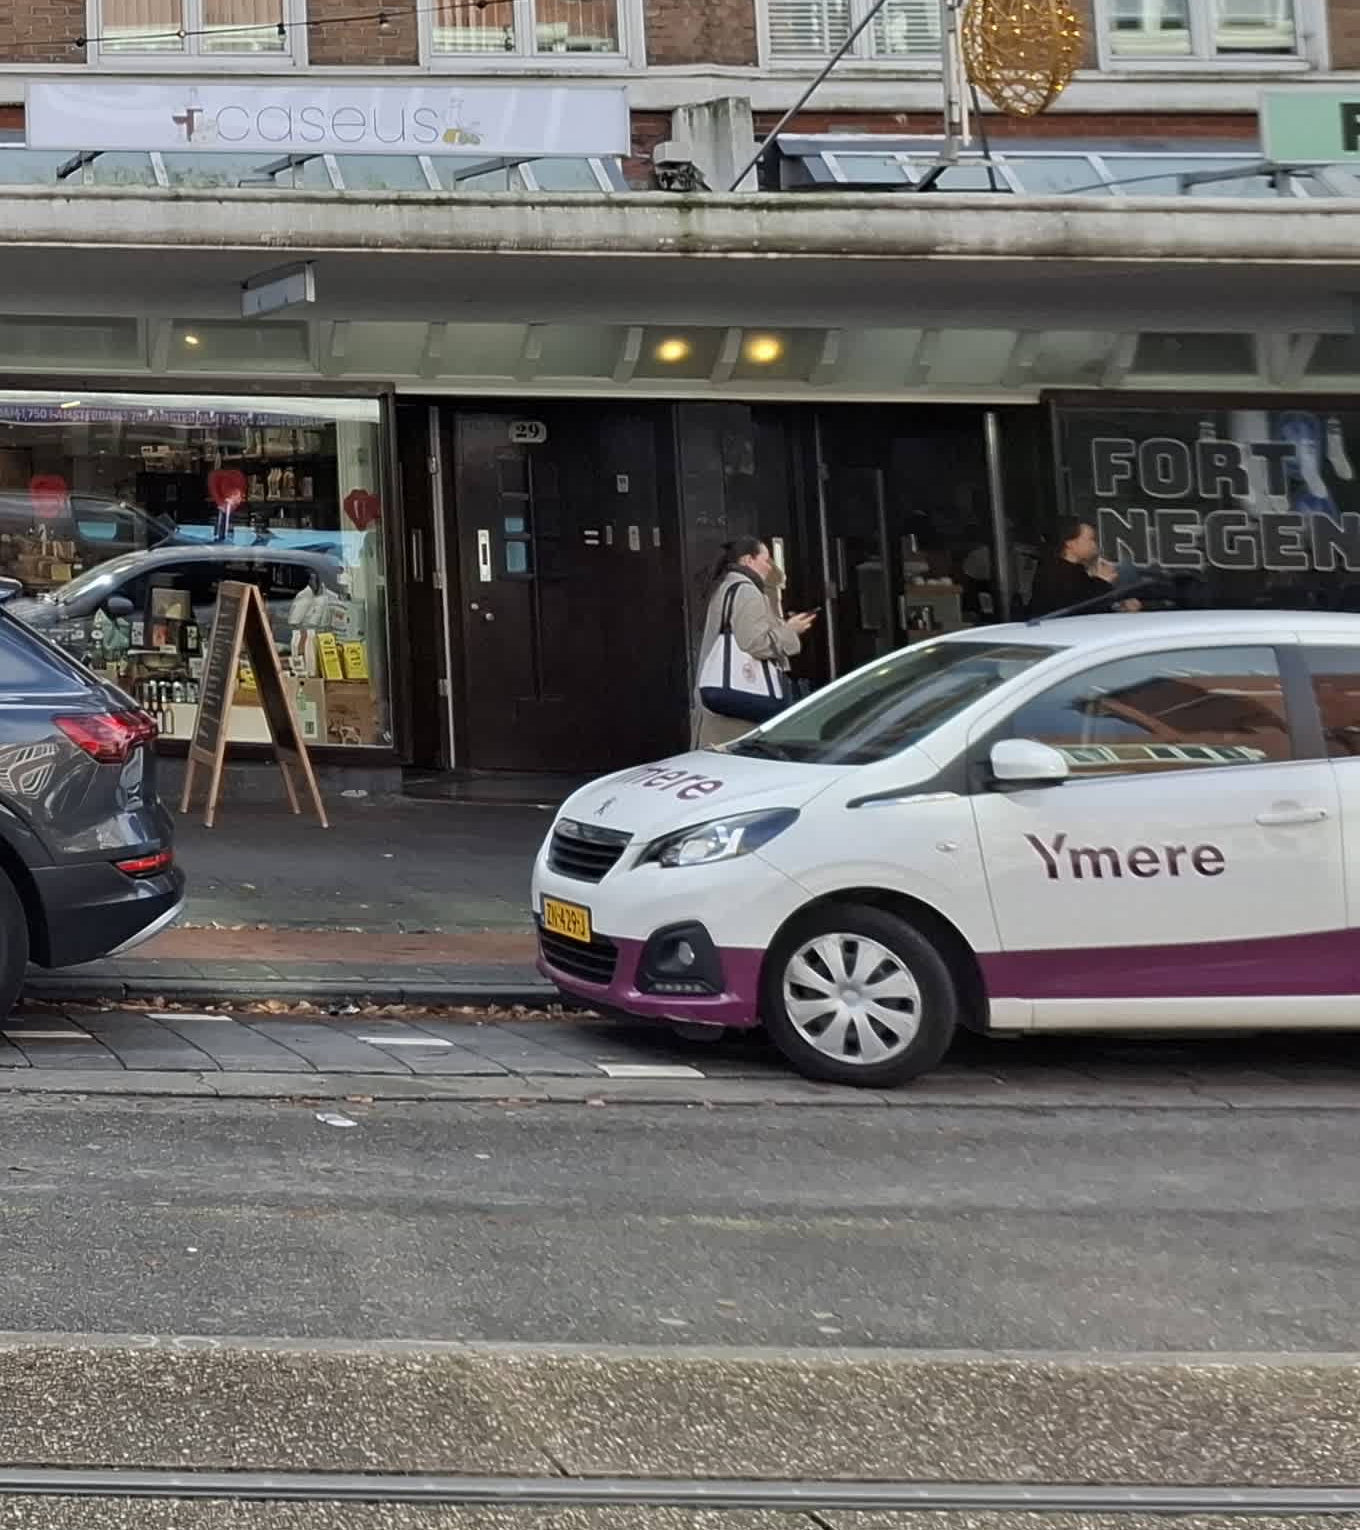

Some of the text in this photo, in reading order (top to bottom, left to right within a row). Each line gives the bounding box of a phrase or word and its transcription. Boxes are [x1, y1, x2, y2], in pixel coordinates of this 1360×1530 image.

[216, 106, 440, 143] caseus
[515, 424, 540, 439] 29
[1092, 438, 1297, 499] FORT
[1024, 832, 1225, 879] Ymere
